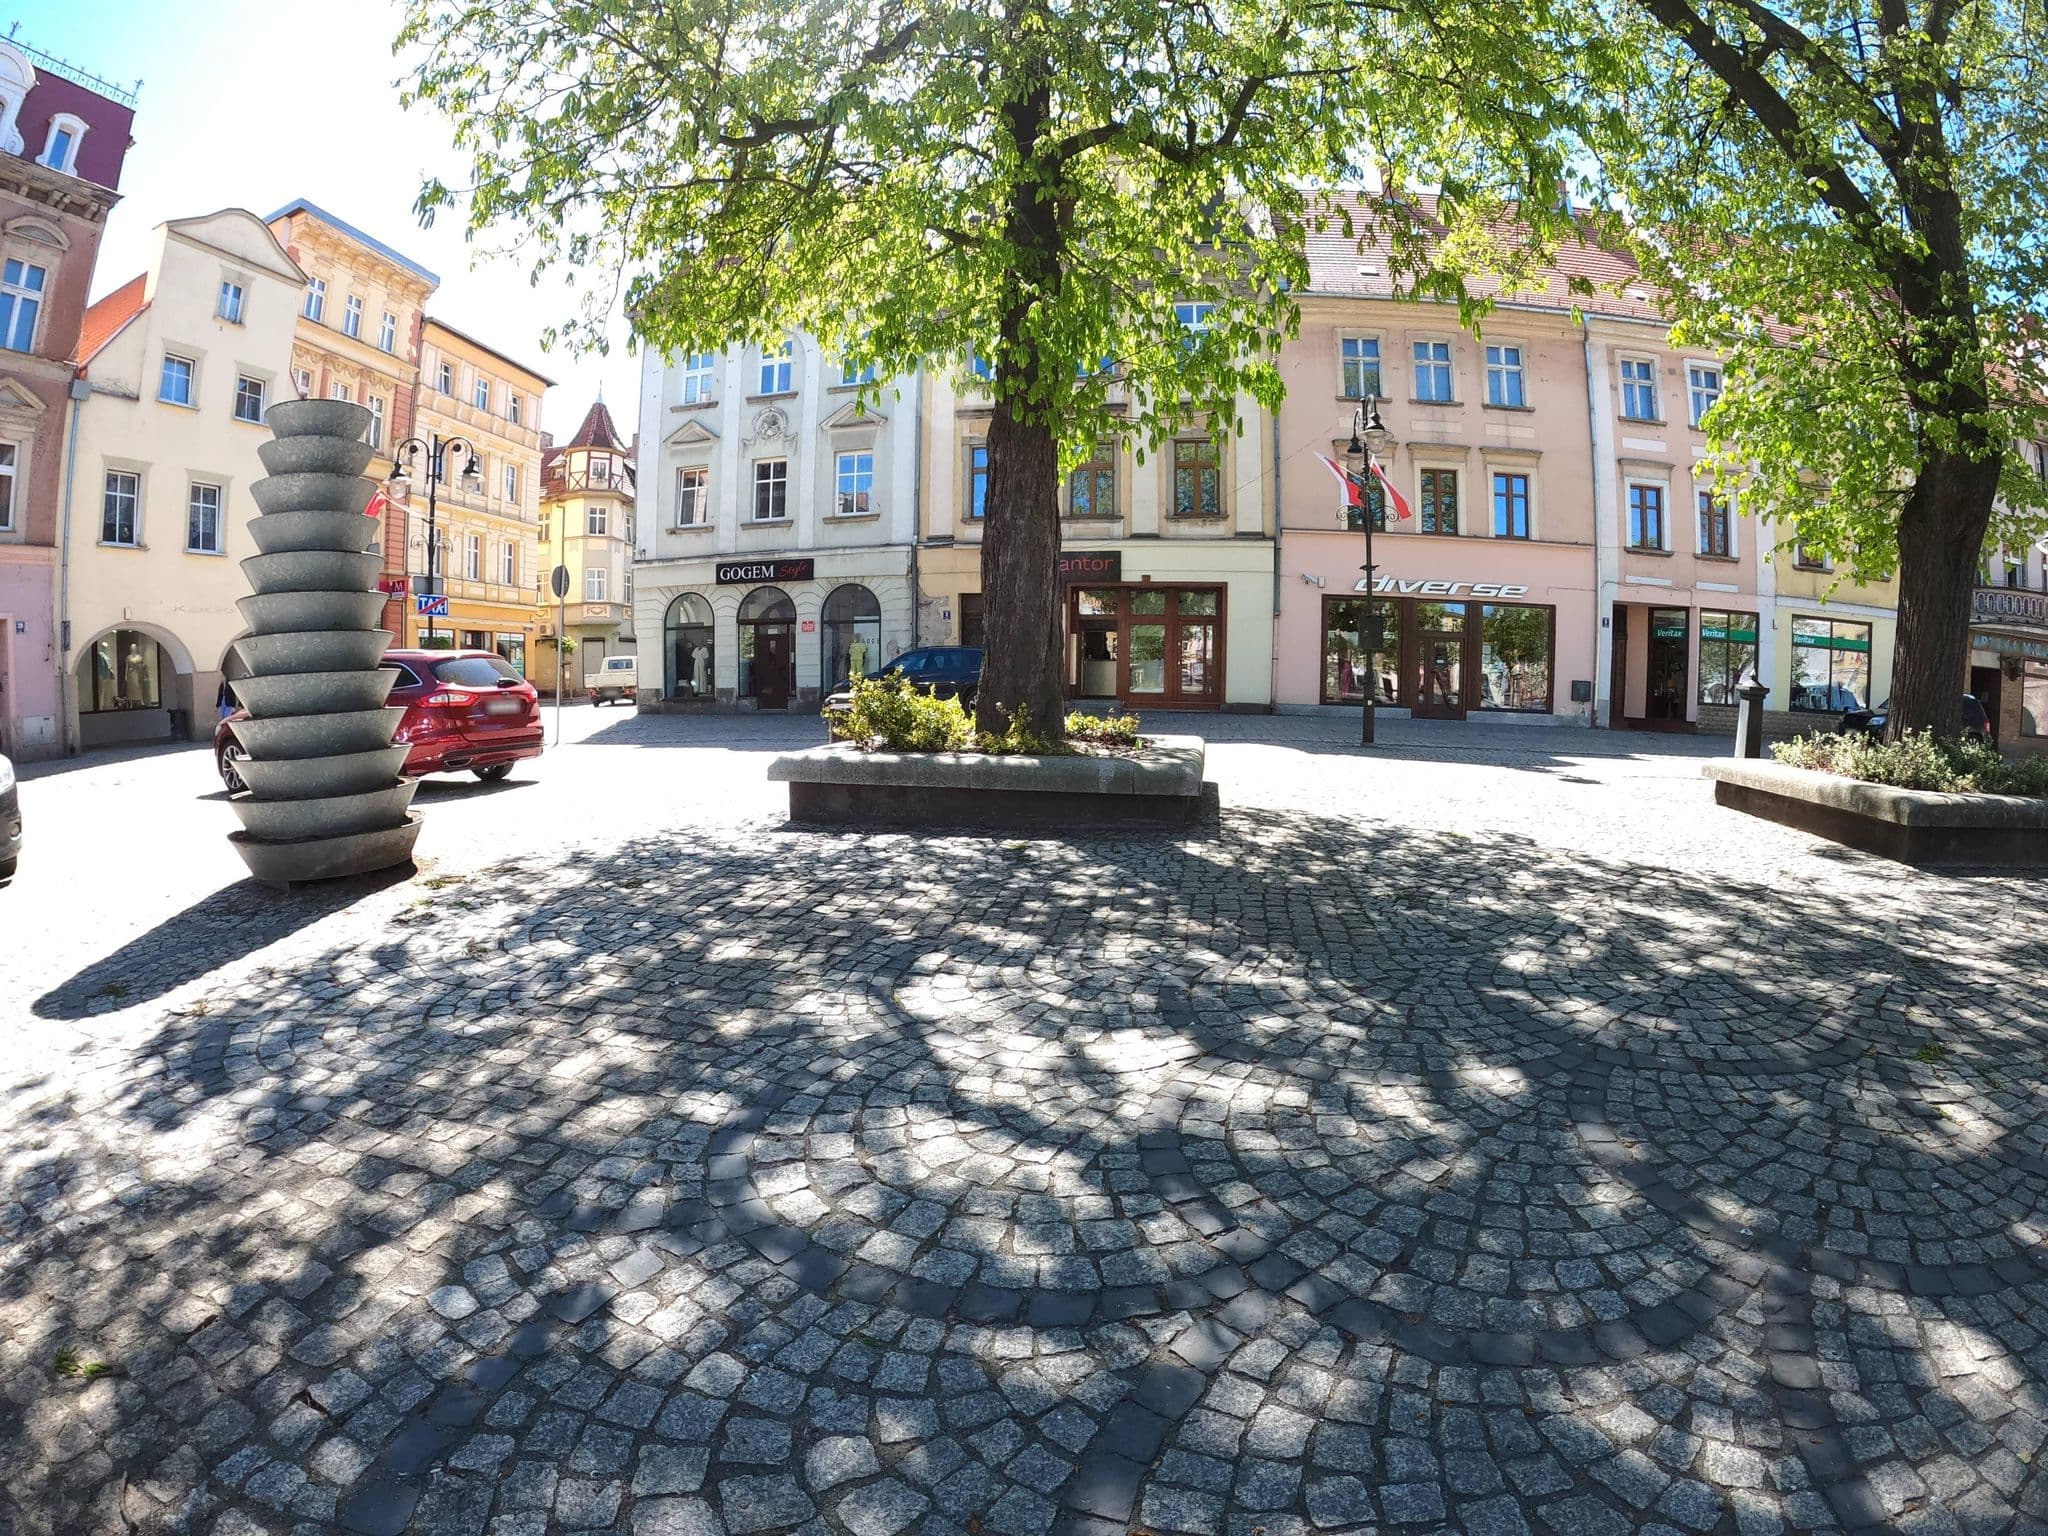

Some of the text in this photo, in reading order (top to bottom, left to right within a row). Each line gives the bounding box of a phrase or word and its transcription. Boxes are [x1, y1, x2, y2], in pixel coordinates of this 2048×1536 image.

[1059, 556, 1114, 571] antor
[720, 564, 774, 580] GOGEM
[1354, 574, 1529, 599] diverse
[419, 597, 447, 614] TAXI
[1656, 628, 1683, 638] Veritax
[1701, 628, 1726, 638] Veritax
